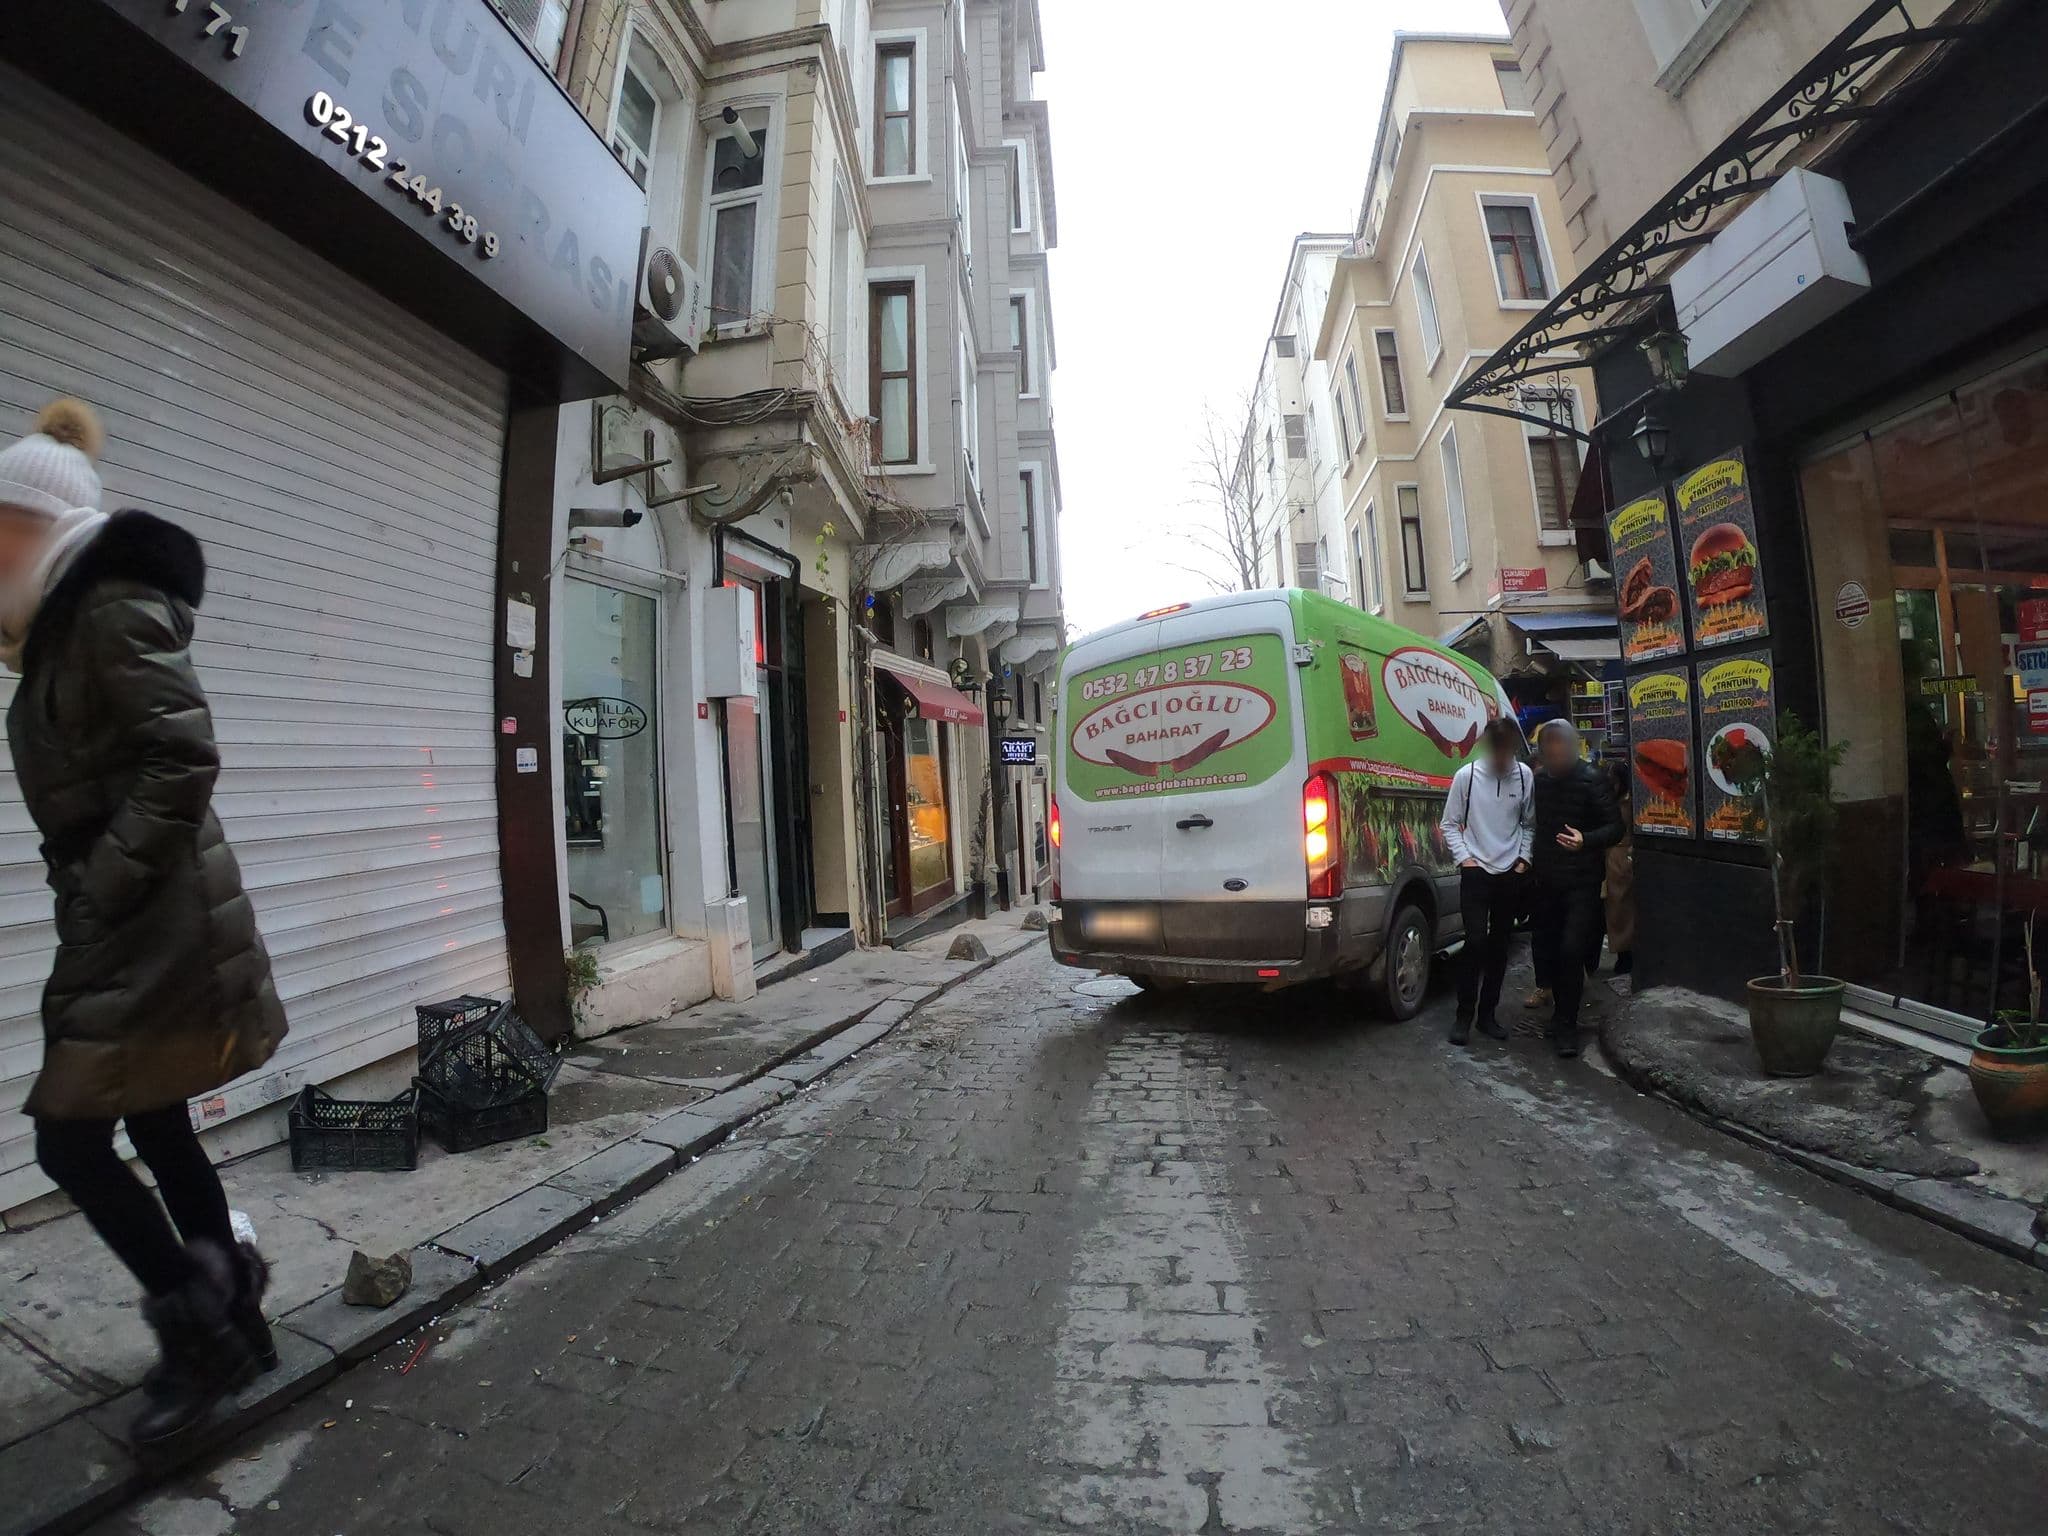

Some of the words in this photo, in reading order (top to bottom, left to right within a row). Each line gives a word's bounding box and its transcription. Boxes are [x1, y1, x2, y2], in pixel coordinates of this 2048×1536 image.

[306, 91, 388, 171] 0212
[386, 157, 443, 214] 244
[447, 203, 478, 244] 38
[1082, 673, 1129, 701] 0532
[1184, 653, 1213, 680] 37
[1219, 646, 1253, 673] 23
[1428, 698, 1467, 720] BAHARAT
[573, 716, 640, 729] KUAFÖR
[1125, 723, 1203, 745] BAHARAT
[1095, 772, 1248, 798] www.bagcioglubaharat.com
